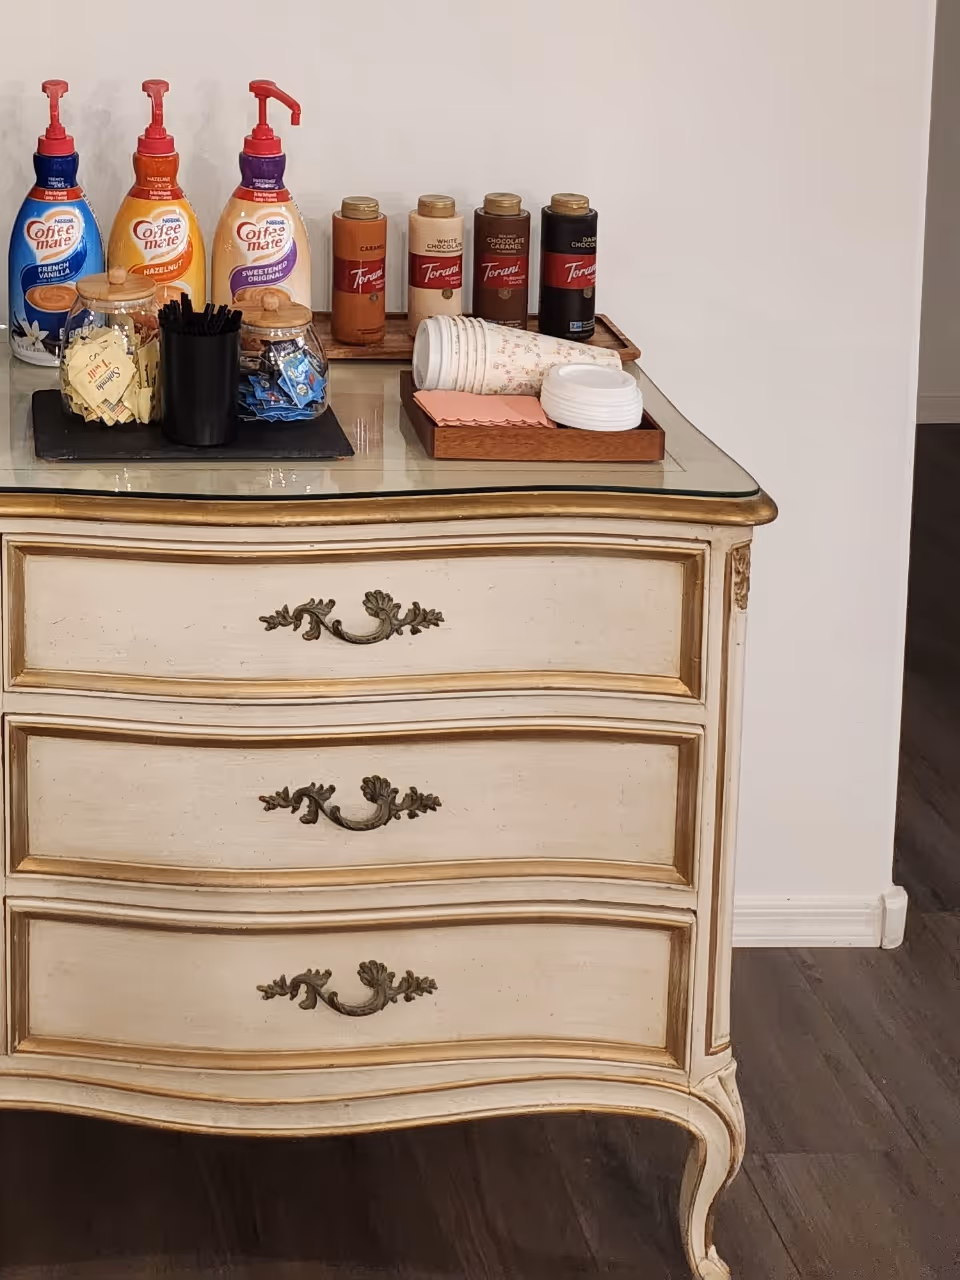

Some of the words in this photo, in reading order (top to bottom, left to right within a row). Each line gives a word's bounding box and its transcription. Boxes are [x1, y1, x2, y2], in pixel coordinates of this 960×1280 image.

[26, 220, 75, 241] Coffee
[133, 220, 182, 241] Coffee
[236, 222, 286, 243] Coffee
[35, 235, 72, 251] mate
[143, 235, 179, 251] mate
[246, 238, 283, 252] mate
[486, 237, 526, 245] CHOCOLATE
[38, 261, 70, 273] FRENCH
[39, 268, 71, 279] VANILLA
[144, 260, 183, 277] HAZELNUT
[242, 261, 288, 277] SWEETENED
[422, 260, 460, 283] Torani
[482, 261, 520, 282] Torani
[248, 271, 284, 283] ORIGINAL
[350, 264, 384, 289] Torani
[95, 366, 121, 392] Splenda
